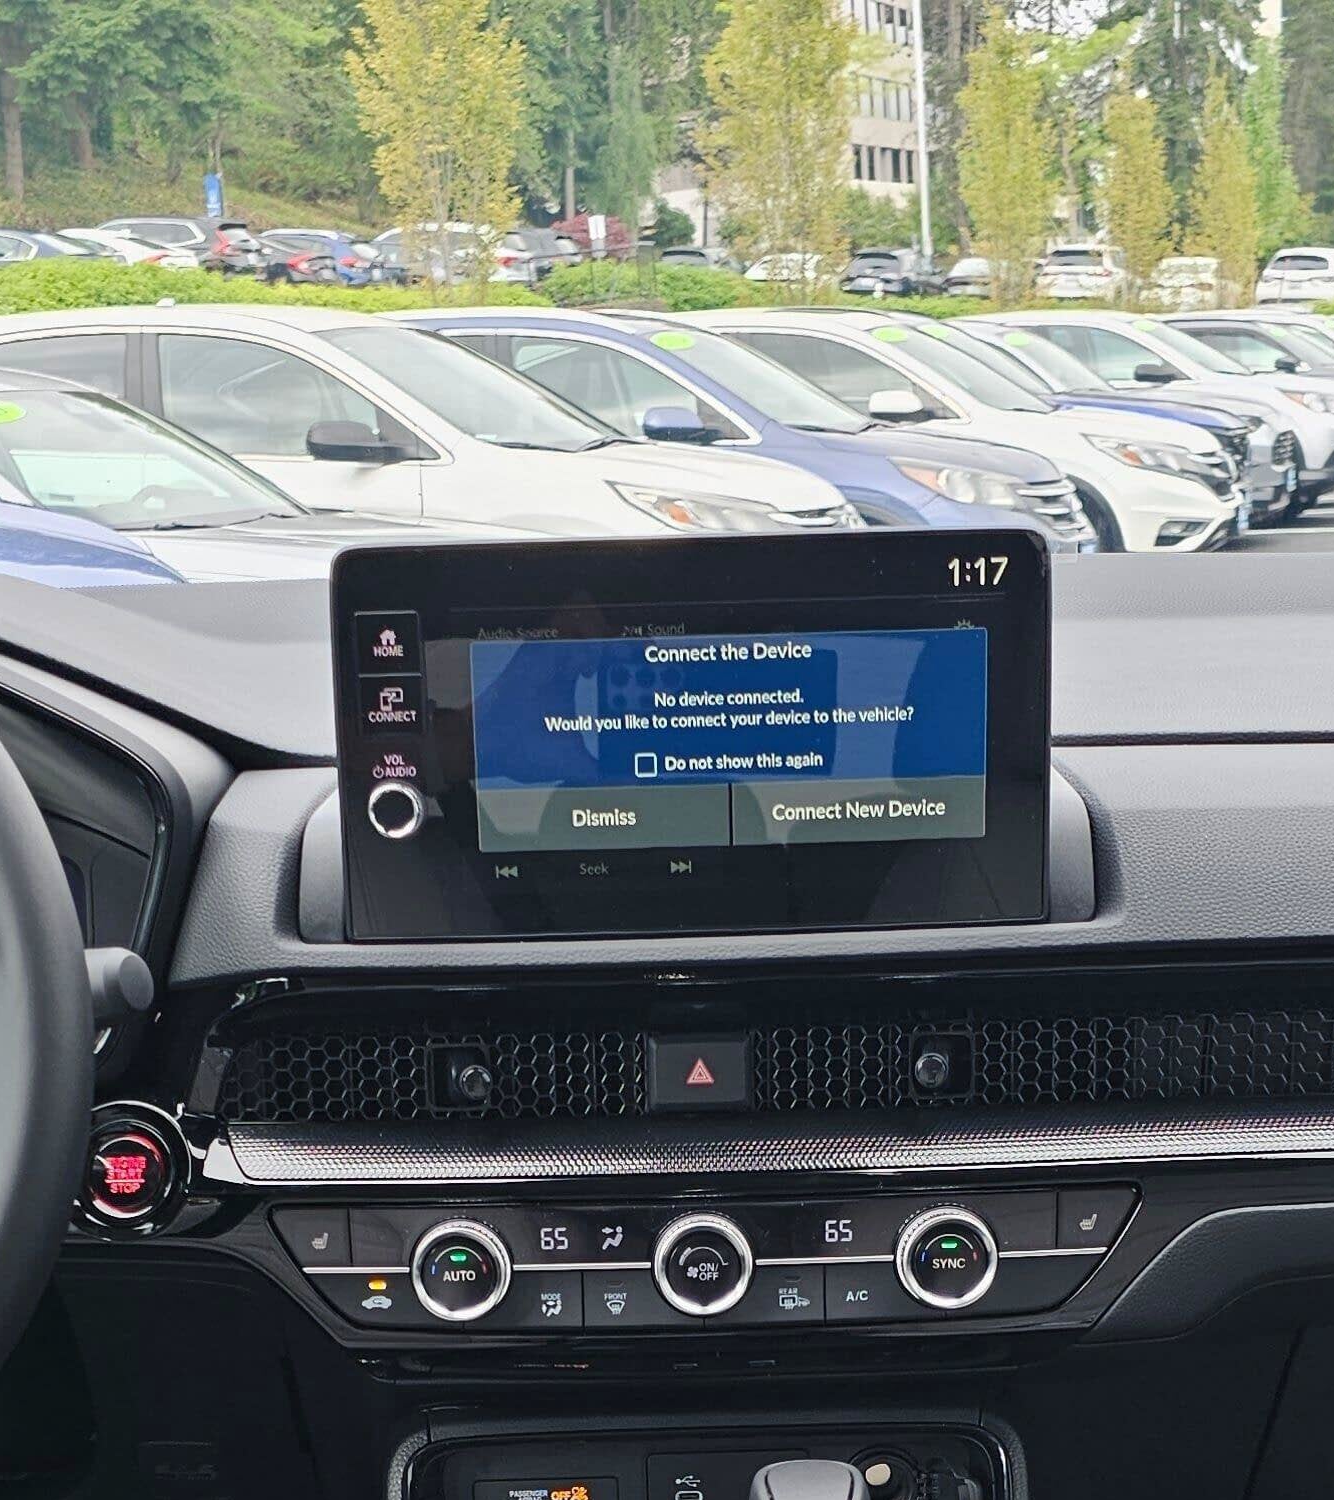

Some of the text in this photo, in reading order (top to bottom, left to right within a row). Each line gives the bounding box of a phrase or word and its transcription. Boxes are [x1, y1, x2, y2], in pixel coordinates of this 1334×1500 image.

[948, 556, 1008, 586] 1:17
[647, 622, 685, 636] Sound
[373, 645, 404, 657] HOME
[644, 641, 812, 663] Connect the Device
[654, 687, 805, 707] No device connected.
[368, 710, 417, 723] CONNECT
[544, 706, 914, 733] Would you like to connect your device to the vehicle?
[384, 754, 405, 766] VOL
[664, 752, 824, 771] Do not show this again
[385, 766, 417, 778] AUDIO
[772, 798, 946, 821] Connect New Device
[571, 808, 637, 828] Dismiss
[579, 862, 610, 876] Seek
[110, 1182, 141, 1194] STOP
[824, 1219, 853, 1243] 65
[540, 1226, 569, 1250] 65
[932, 1257, 966, 1270] SYNC
[443, 1271, 476, 1283] AUTO
[699, 1271, 719, 1281] OFF
[541, 1293, 562, 1301] MODE
[604, 1292, 628, 1301] FRONT
[778, 1287, 798, 1296] REAR
[846, 1290, 869, 1302] A/C
[509, 1489, 548, 1498] PASSENGER
